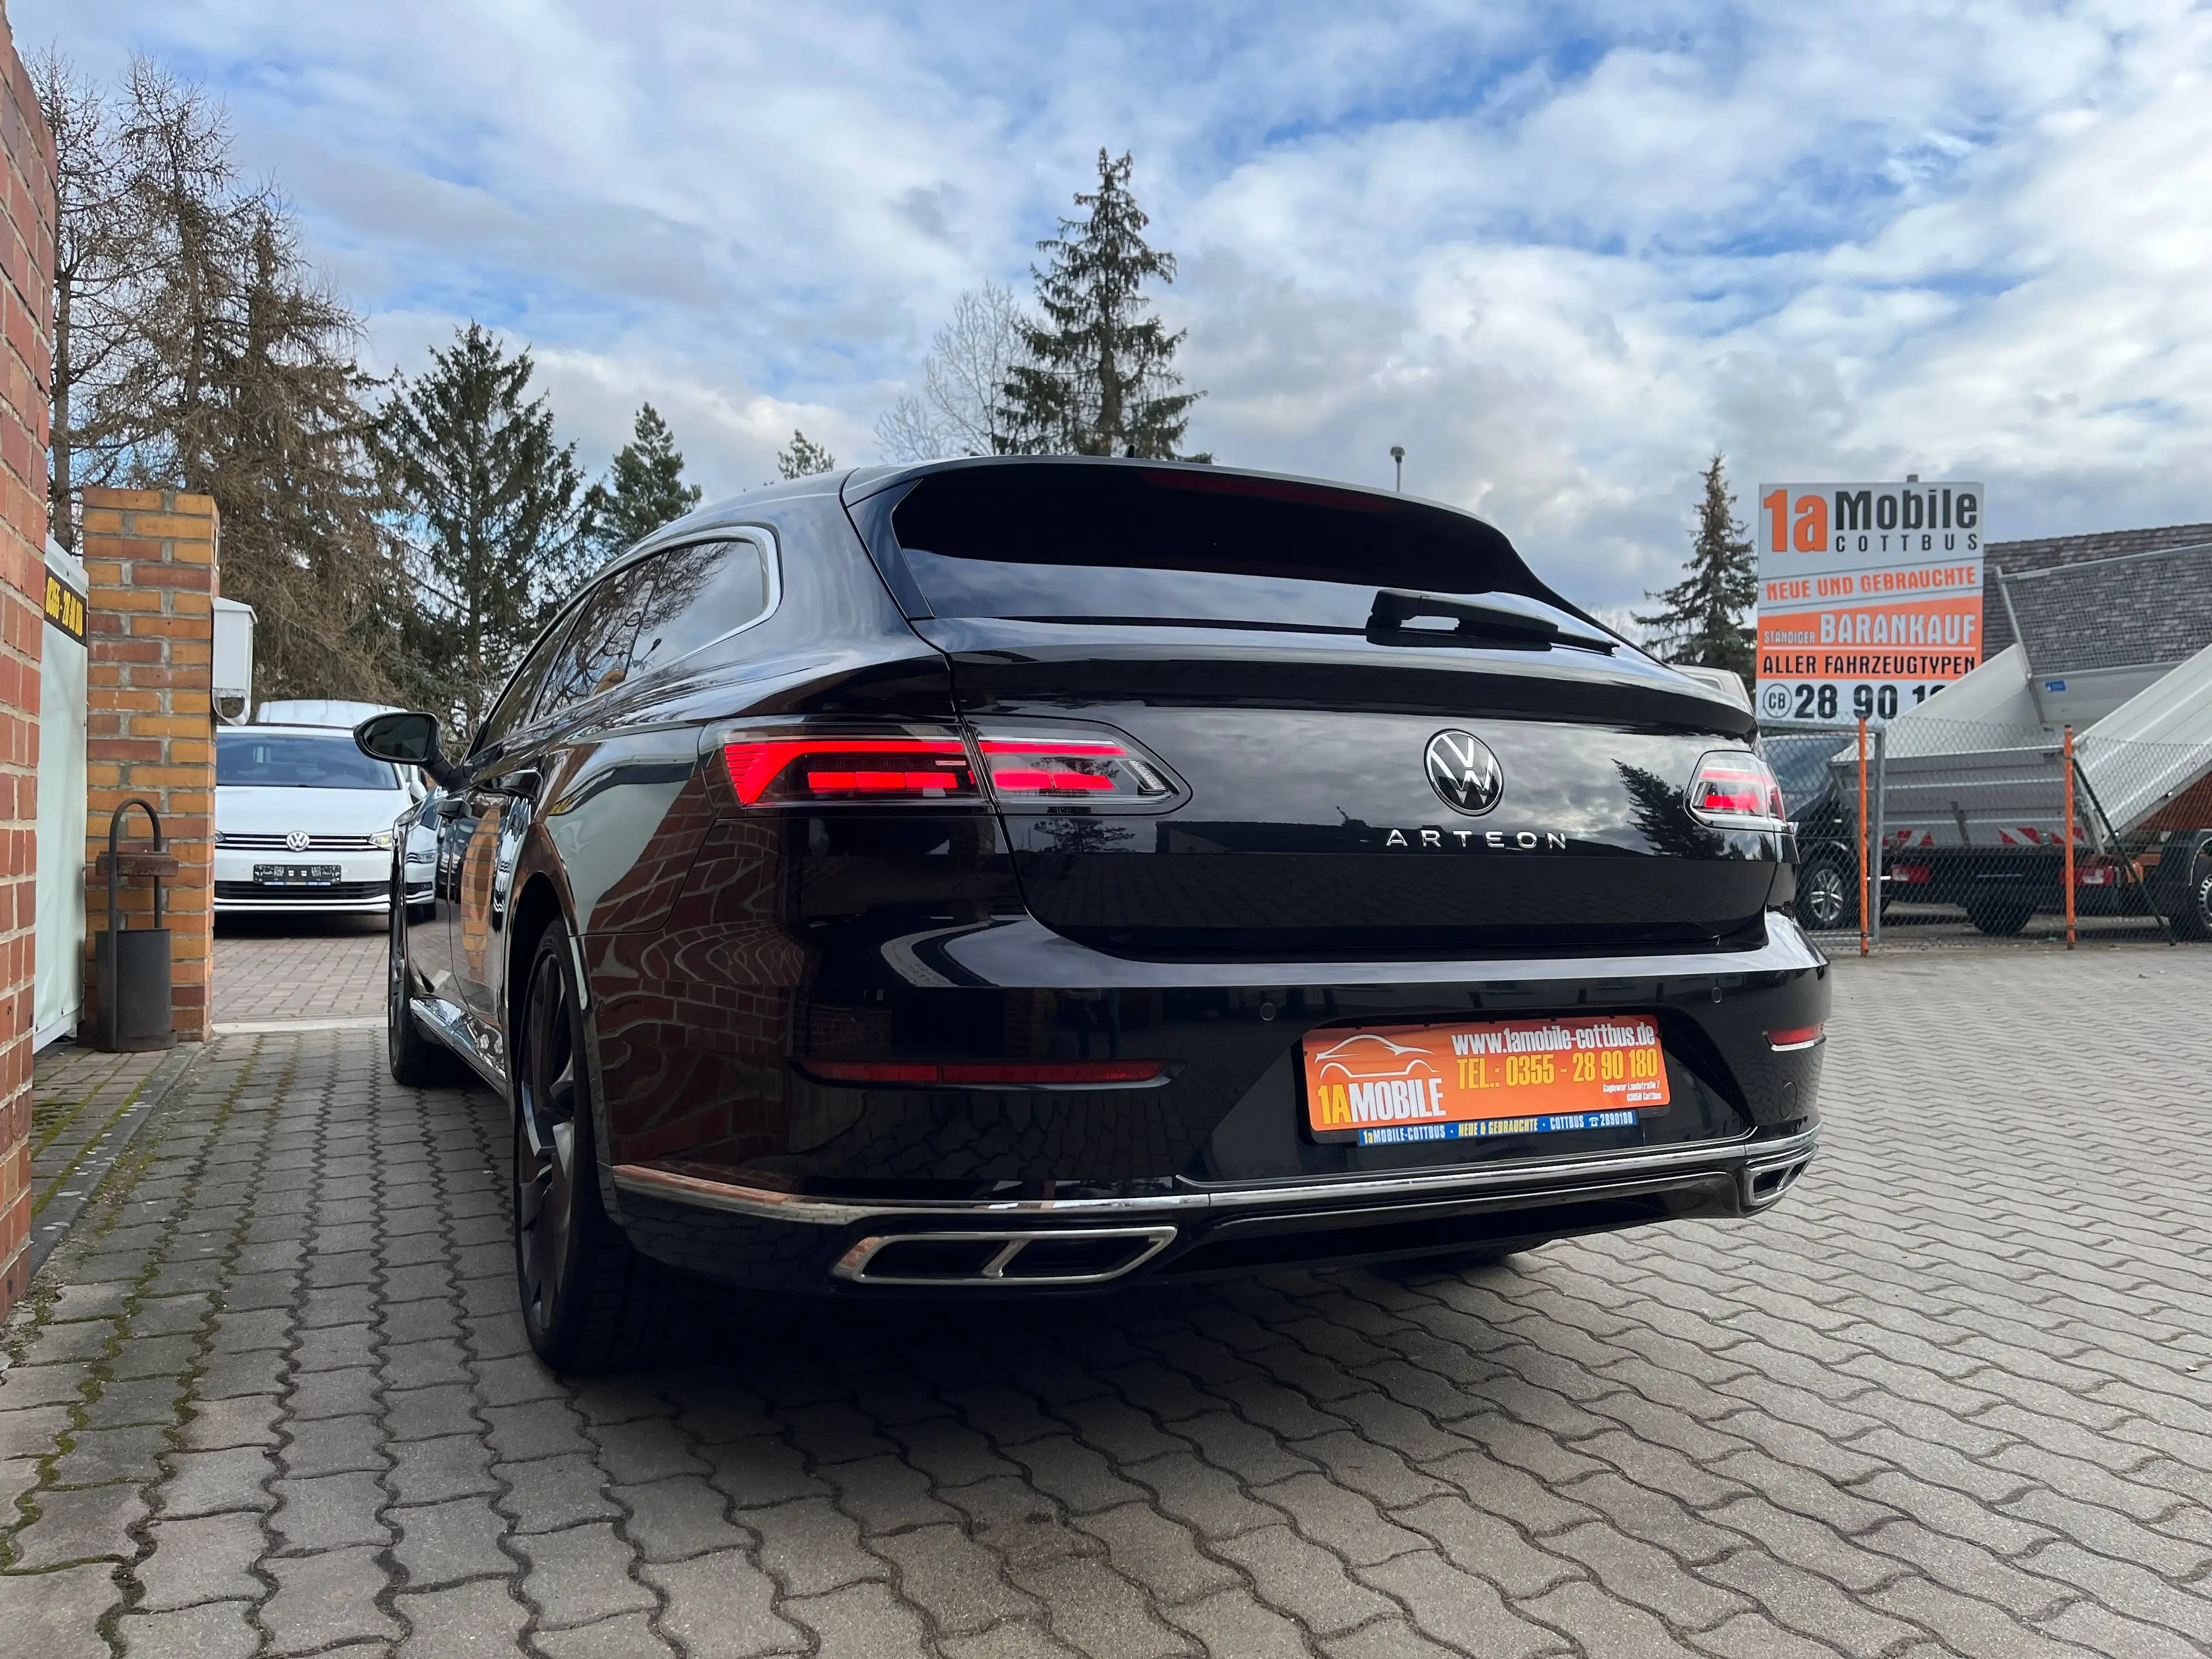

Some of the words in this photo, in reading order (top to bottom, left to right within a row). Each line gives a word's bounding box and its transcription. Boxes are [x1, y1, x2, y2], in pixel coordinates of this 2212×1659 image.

[1763, 489, 1828, 552] 1a
[1835, 489, 1977, 530] Mobile
[1836, 533, 1977, 552] COTTBUS
[1767, 581, 1810, 600] NEUE
[1817, 576, 1853, 596] UND
[1860, 566, 1976, 592] GEBRAUCHTE
[1764, 630, 1815, 643] STÄNDIGER
[1820, 613, 1976, 645] BARANKAUF
[1763, 656, 1816, 673] ALLER
[1825, 656, 1975, 674] FAHRZEUGTYPEN
[1768, 693, 1786, 709] CB
[1795, 684, 1838, 718] 28
[1853, 684, 1898, 719] 90
[1912, 685, 1945, 704] 1
[1386, 829, 1566, 850] ARTEON
[1451, 1022, 1656, 1055] www.1amobile-cottbus.de
[1506, 1054, 1555, 1087] 0355
[1572, 1051, 1596, 1082] 28
[1601, 1050, 1624, 1080] 90
[1628, 1048, 1658, 1078] 180
[1317, 1078, 1446, 1124] 1AMOBILE
[1363, 1125, 1445, 1144] 1aMOBILE-COTTBUS
[1459, 1123, 1478, 1137] NEUE
[1488, 1119, 1537, 1135] GEBRAUCHTE
[1550, 1115, 1584, 1130] COTTBUS
